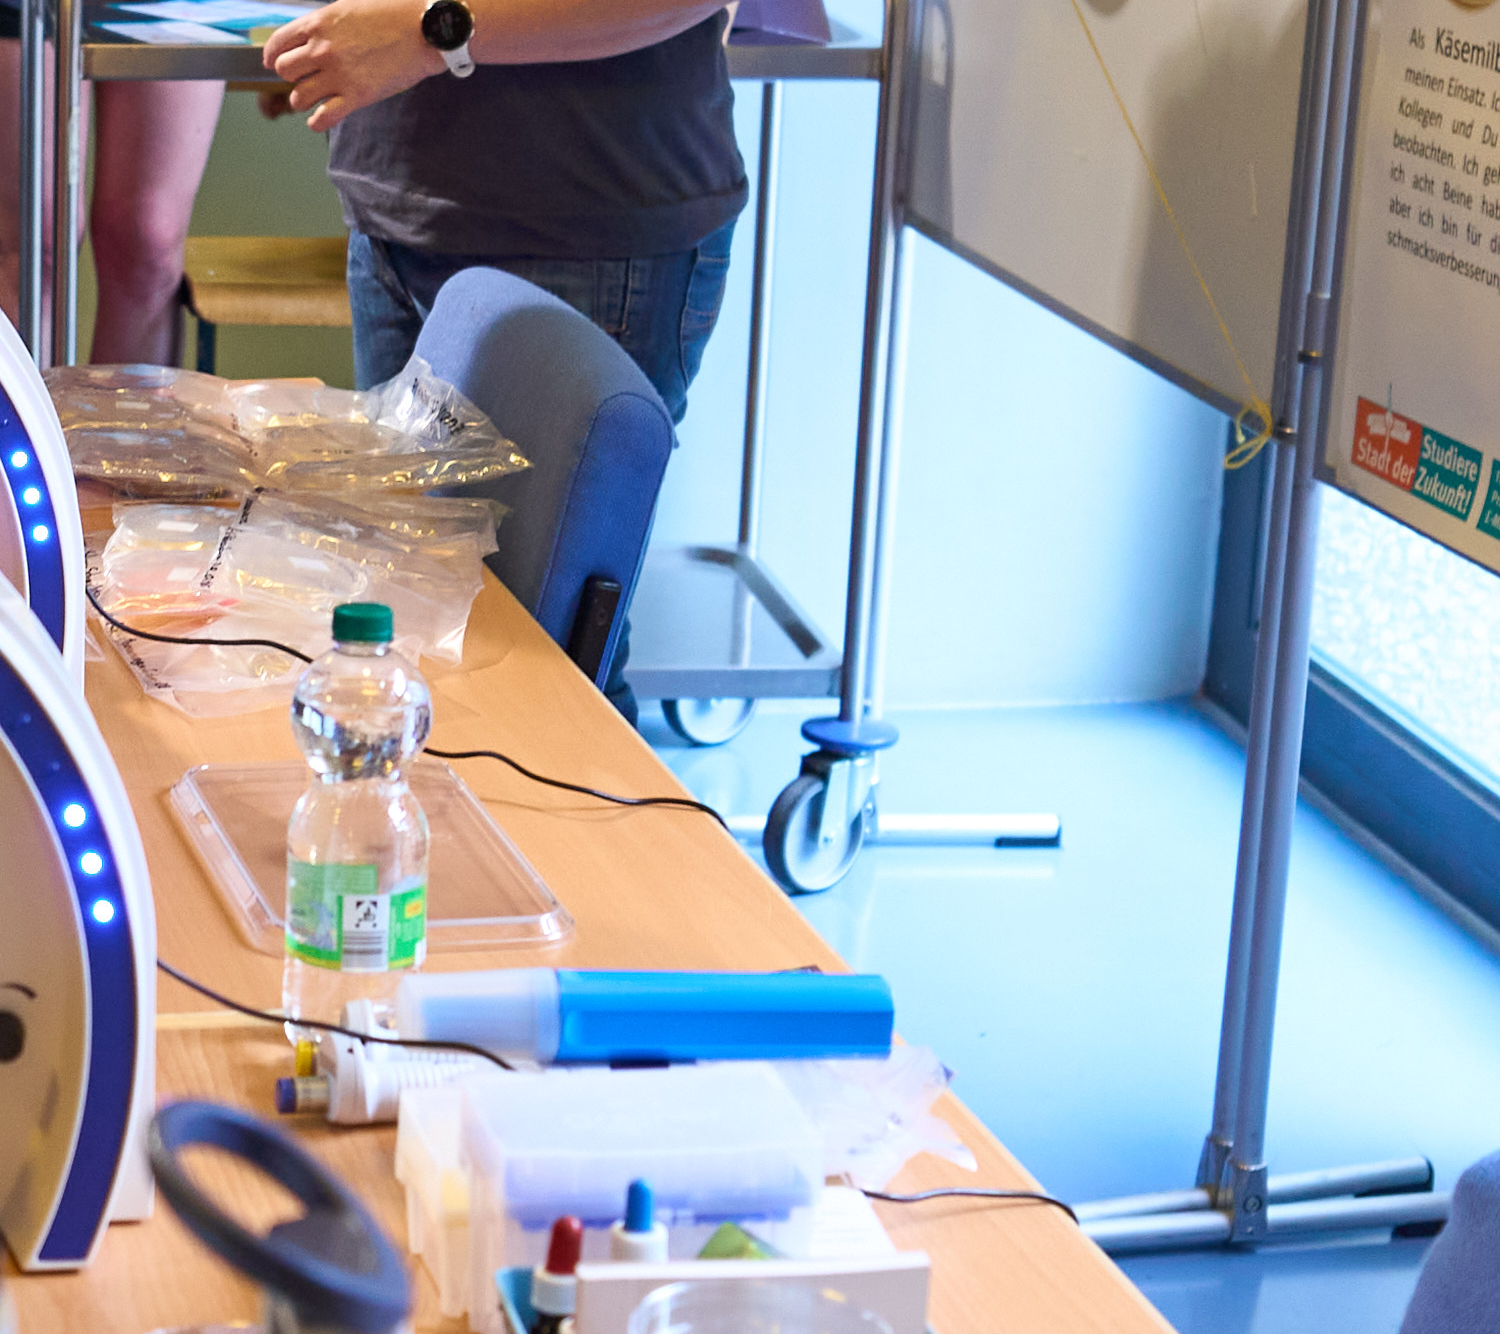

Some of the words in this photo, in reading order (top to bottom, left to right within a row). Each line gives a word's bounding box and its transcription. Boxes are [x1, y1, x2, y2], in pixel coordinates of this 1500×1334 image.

[1409, 28, 1425, 50] Als
[1404, 68, 1445, 92] meinen
[1448, 77, 1487, 108] Einsatz.
[1398, 97, 1443, 130] Kollegen
[1451, 118, 1475, 140] und
[1482, 124, 1499, 147] Du
[1393, 129, 1456, 170] beobachten.
[1462, 153, 1479, 176] Ich
[1390, 161, 1405, 184] ich
[1412, 173, 1435, 196] acht
[1443, 181, 1473, 210] Beine
[1389, 195, 1412, 218] aber
[1418, 206, 1434, 229] ich
[1442, 216, 1458, 238] bin
[1466, 223, 1482, 247] für
[1357, 438, 1391, 474] Stadt
[1392, 454, 1416, 486] der
[1421, 433, 1479, 483] Studiere
[1414, 466, 1473, 514] Zukunft!
